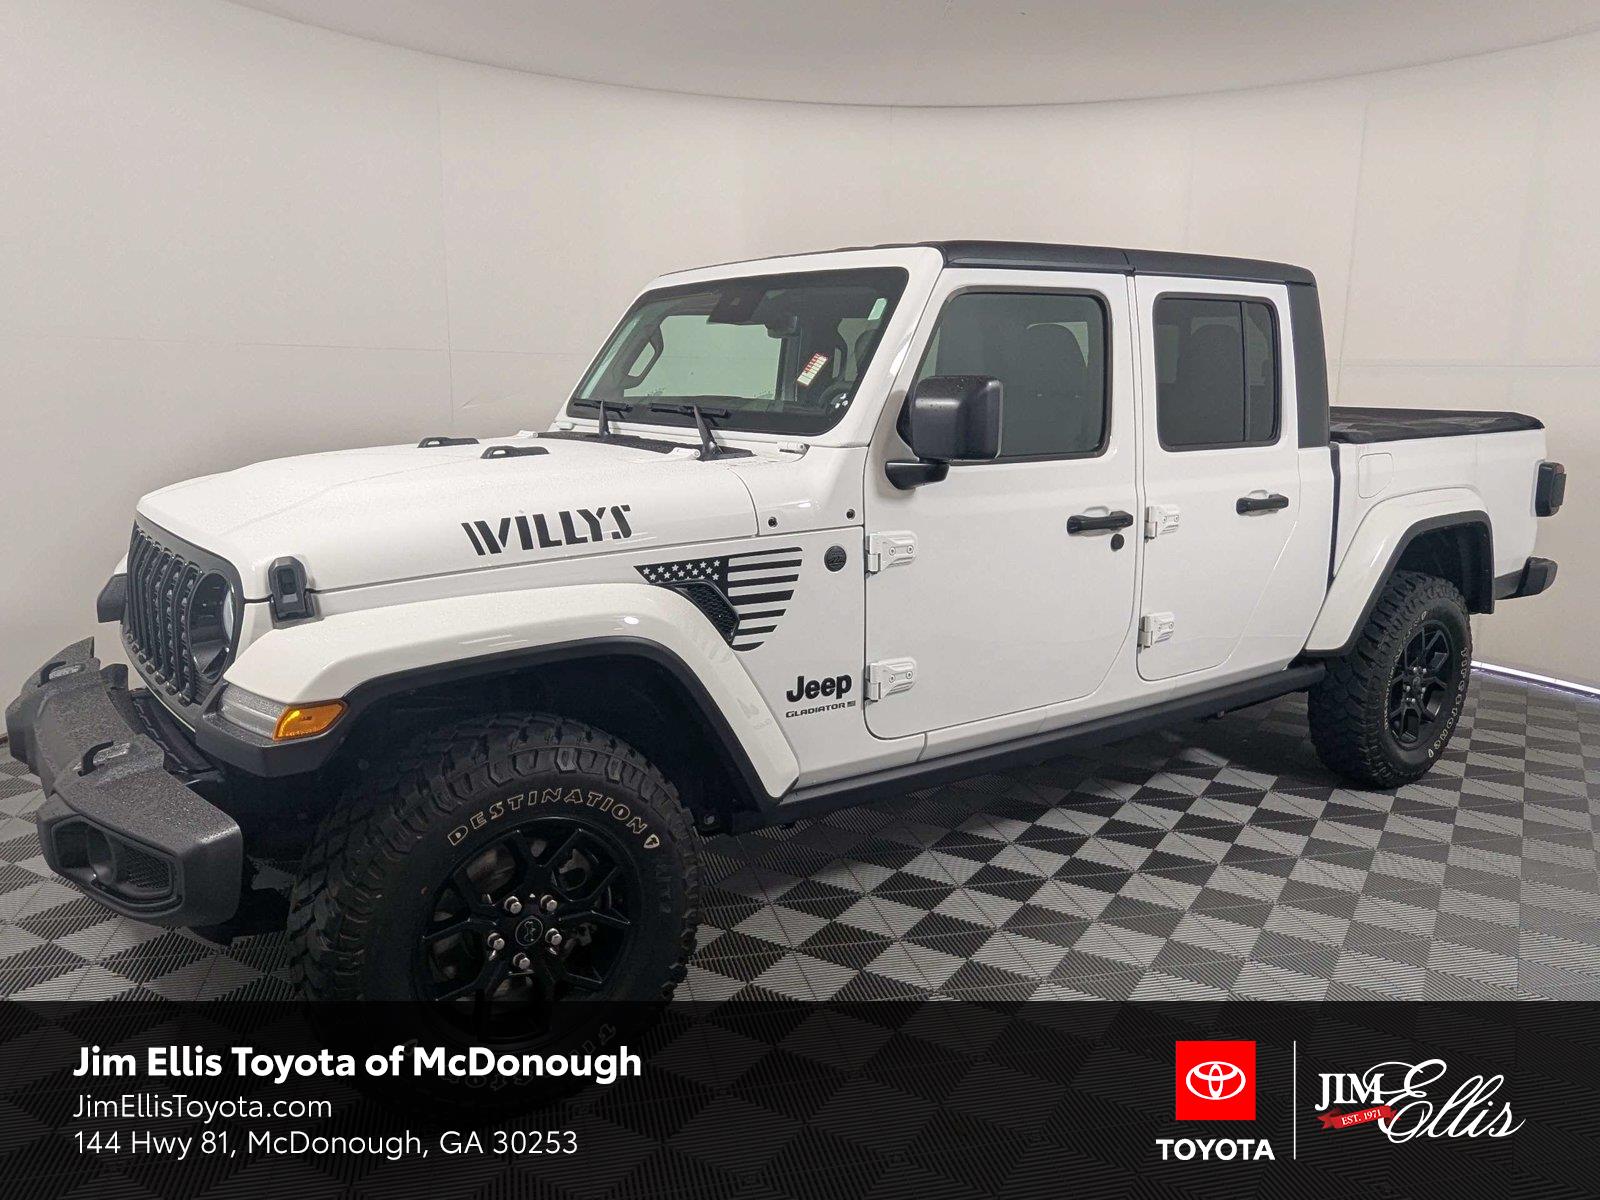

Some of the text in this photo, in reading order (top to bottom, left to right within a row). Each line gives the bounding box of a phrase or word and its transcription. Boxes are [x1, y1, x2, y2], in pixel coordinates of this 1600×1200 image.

[460, 504, 633, 556] WILLYS
[786, 674, 852, 702] Jeep
[786, 702, 846, 718] GLADIATOR
[447, 786, 648, 847] DESTINATION
